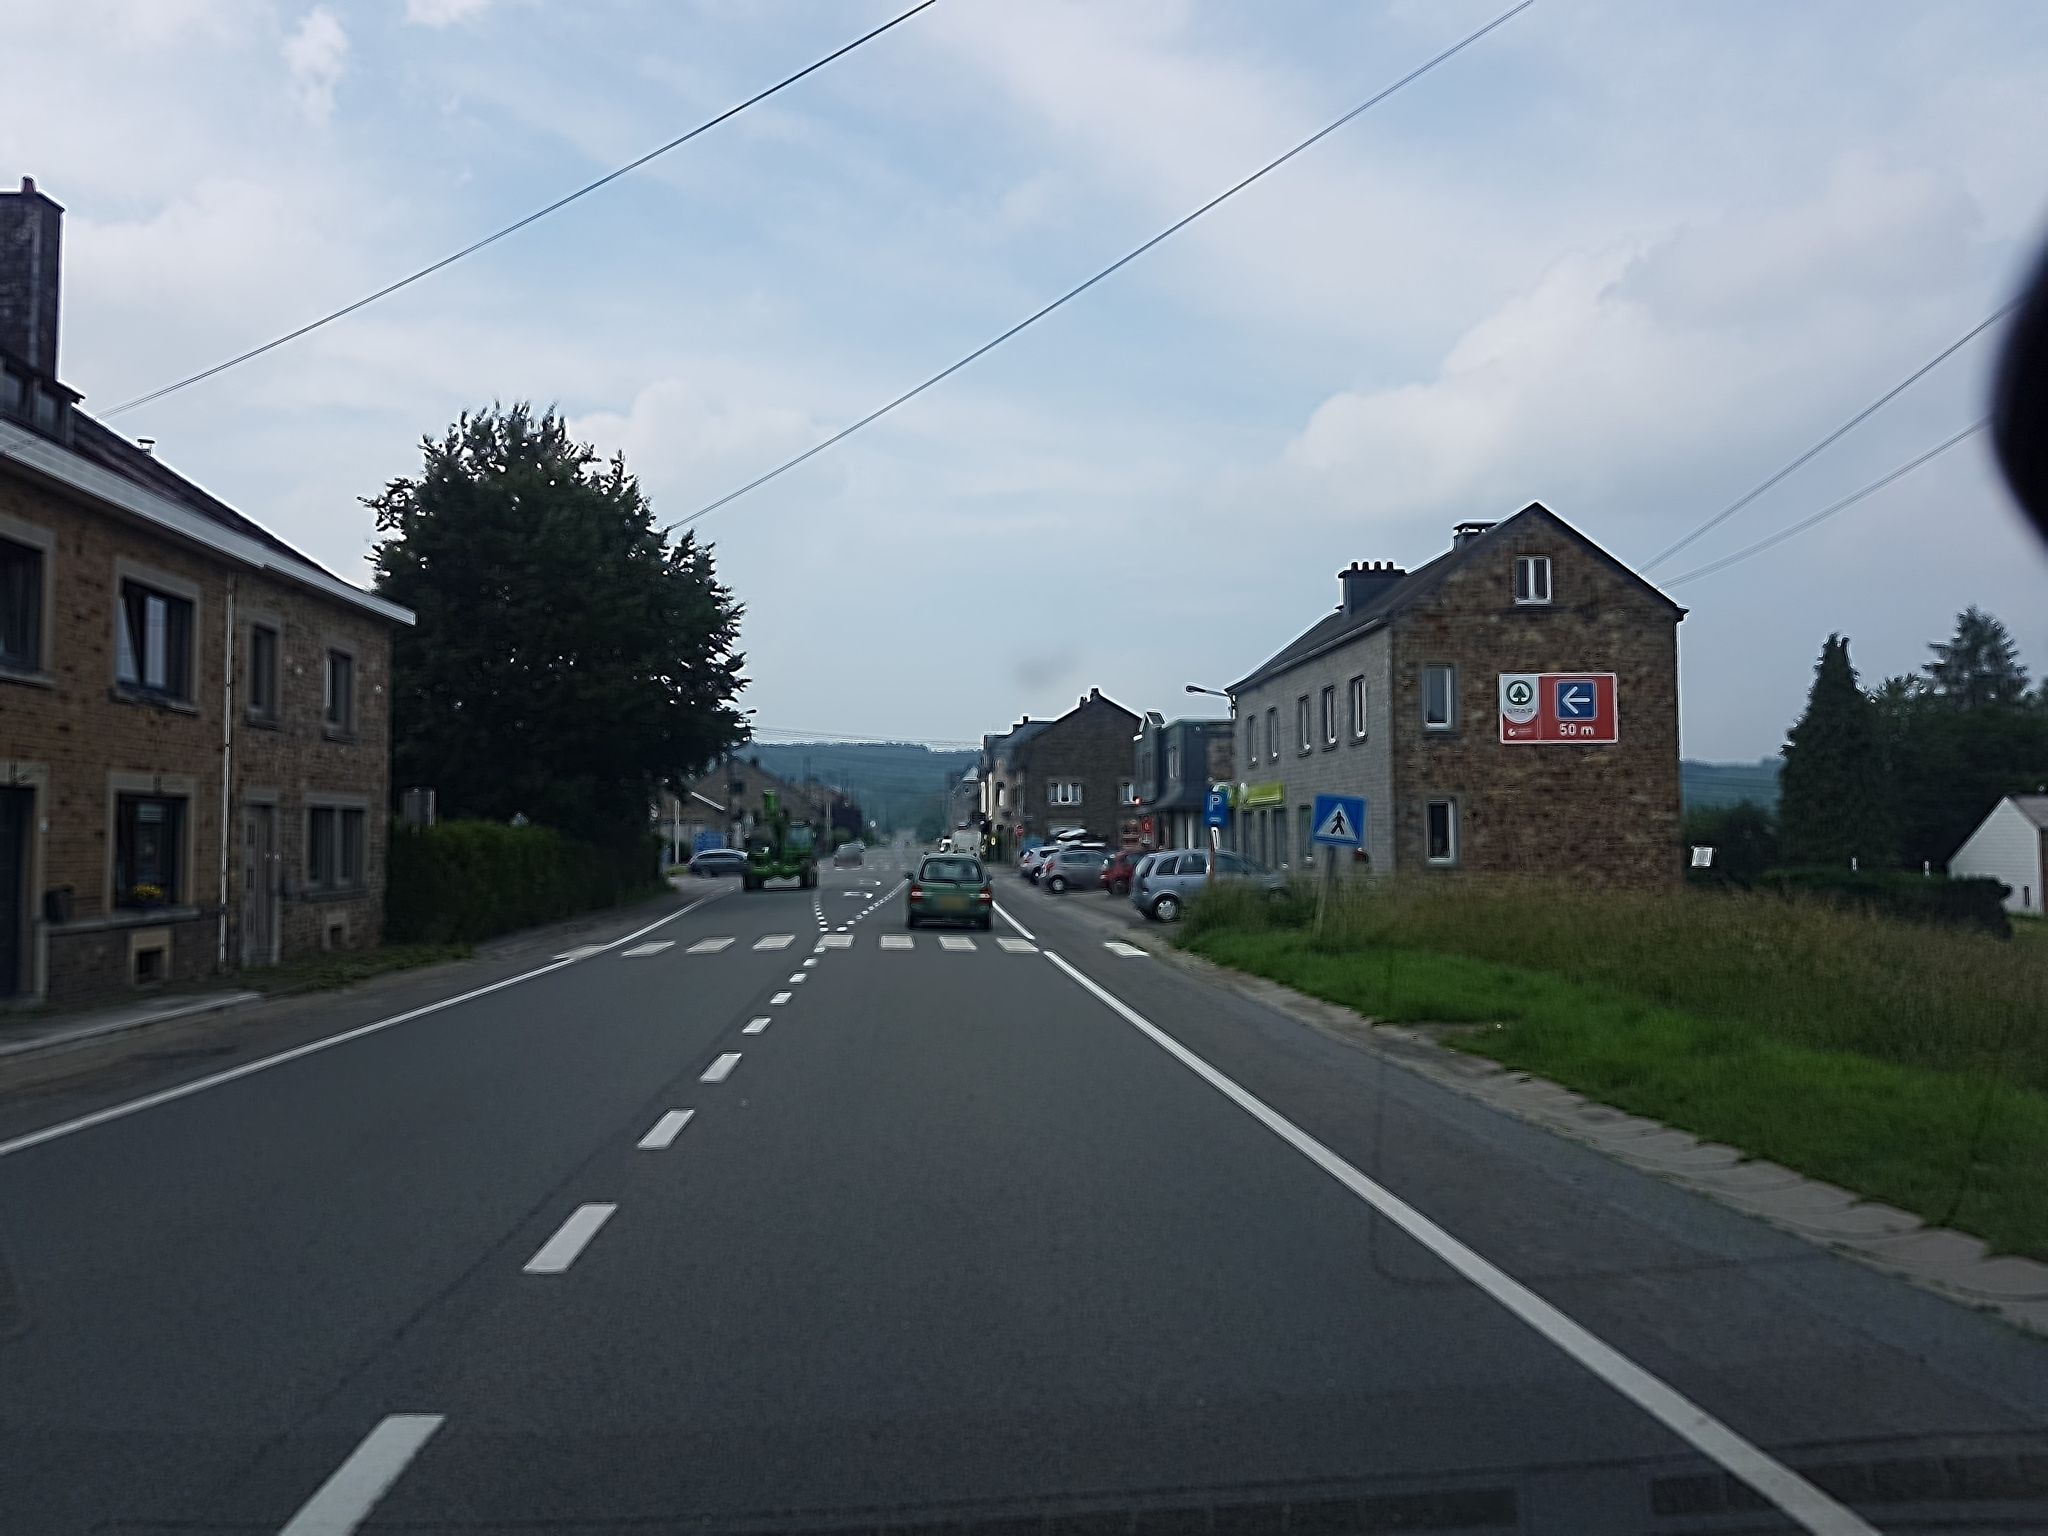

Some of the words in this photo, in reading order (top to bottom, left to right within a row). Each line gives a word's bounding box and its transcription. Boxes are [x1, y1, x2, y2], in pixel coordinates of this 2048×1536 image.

[1559, 723, 1577, 736] 50
[1580, 725, 1595, 736] m
[1209, 794, 1222, 812] P
